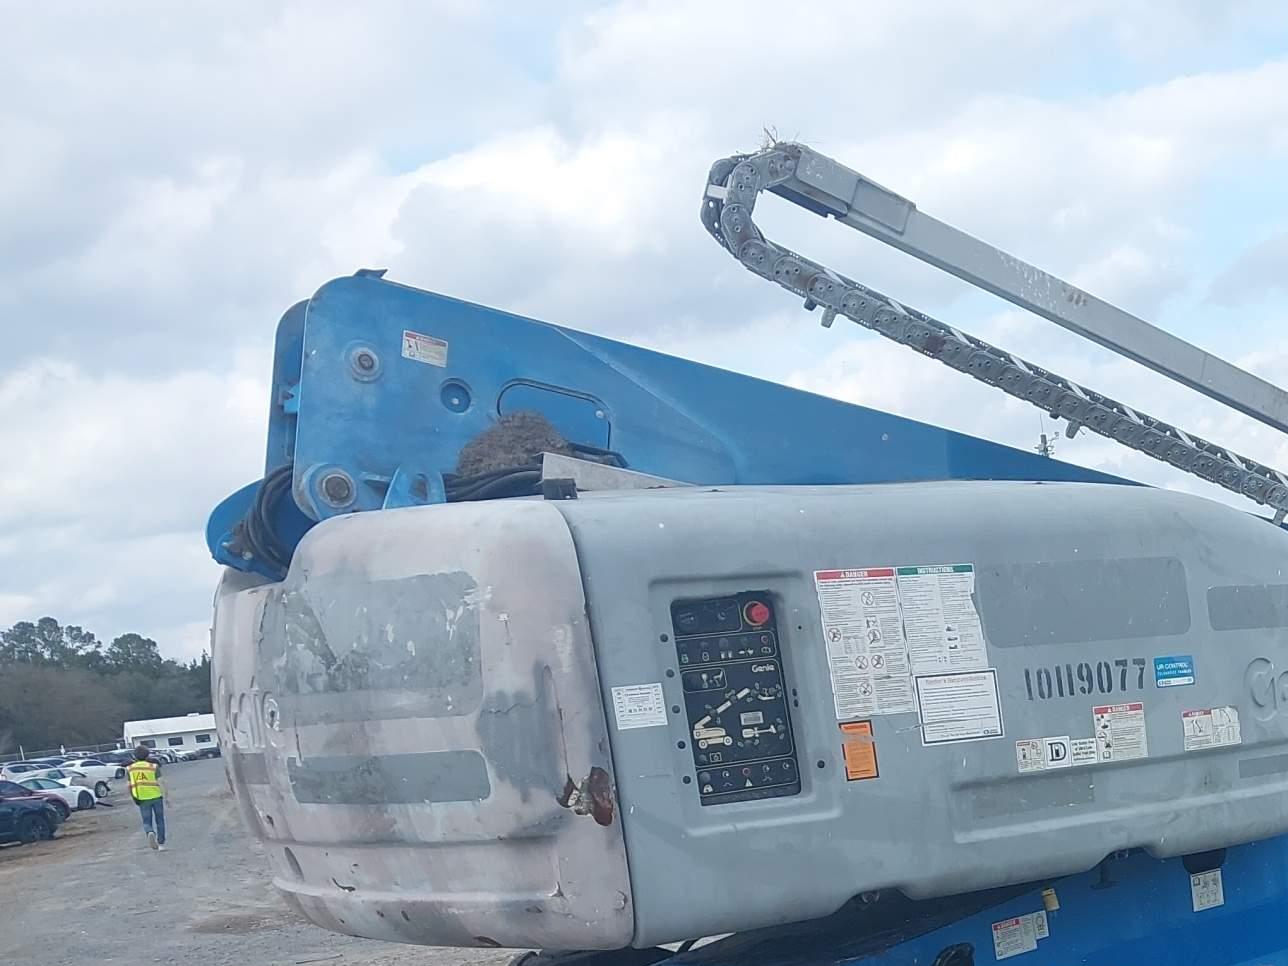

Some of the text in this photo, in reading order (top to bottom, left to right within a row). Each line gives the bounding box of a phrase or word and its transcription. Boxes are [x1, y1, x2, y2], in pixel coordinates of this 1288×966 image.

[845, 571, 868, 579] DANGER
[751, 663, 775, 673] Genie
[1024, 657, 1146, 701] 10119077
